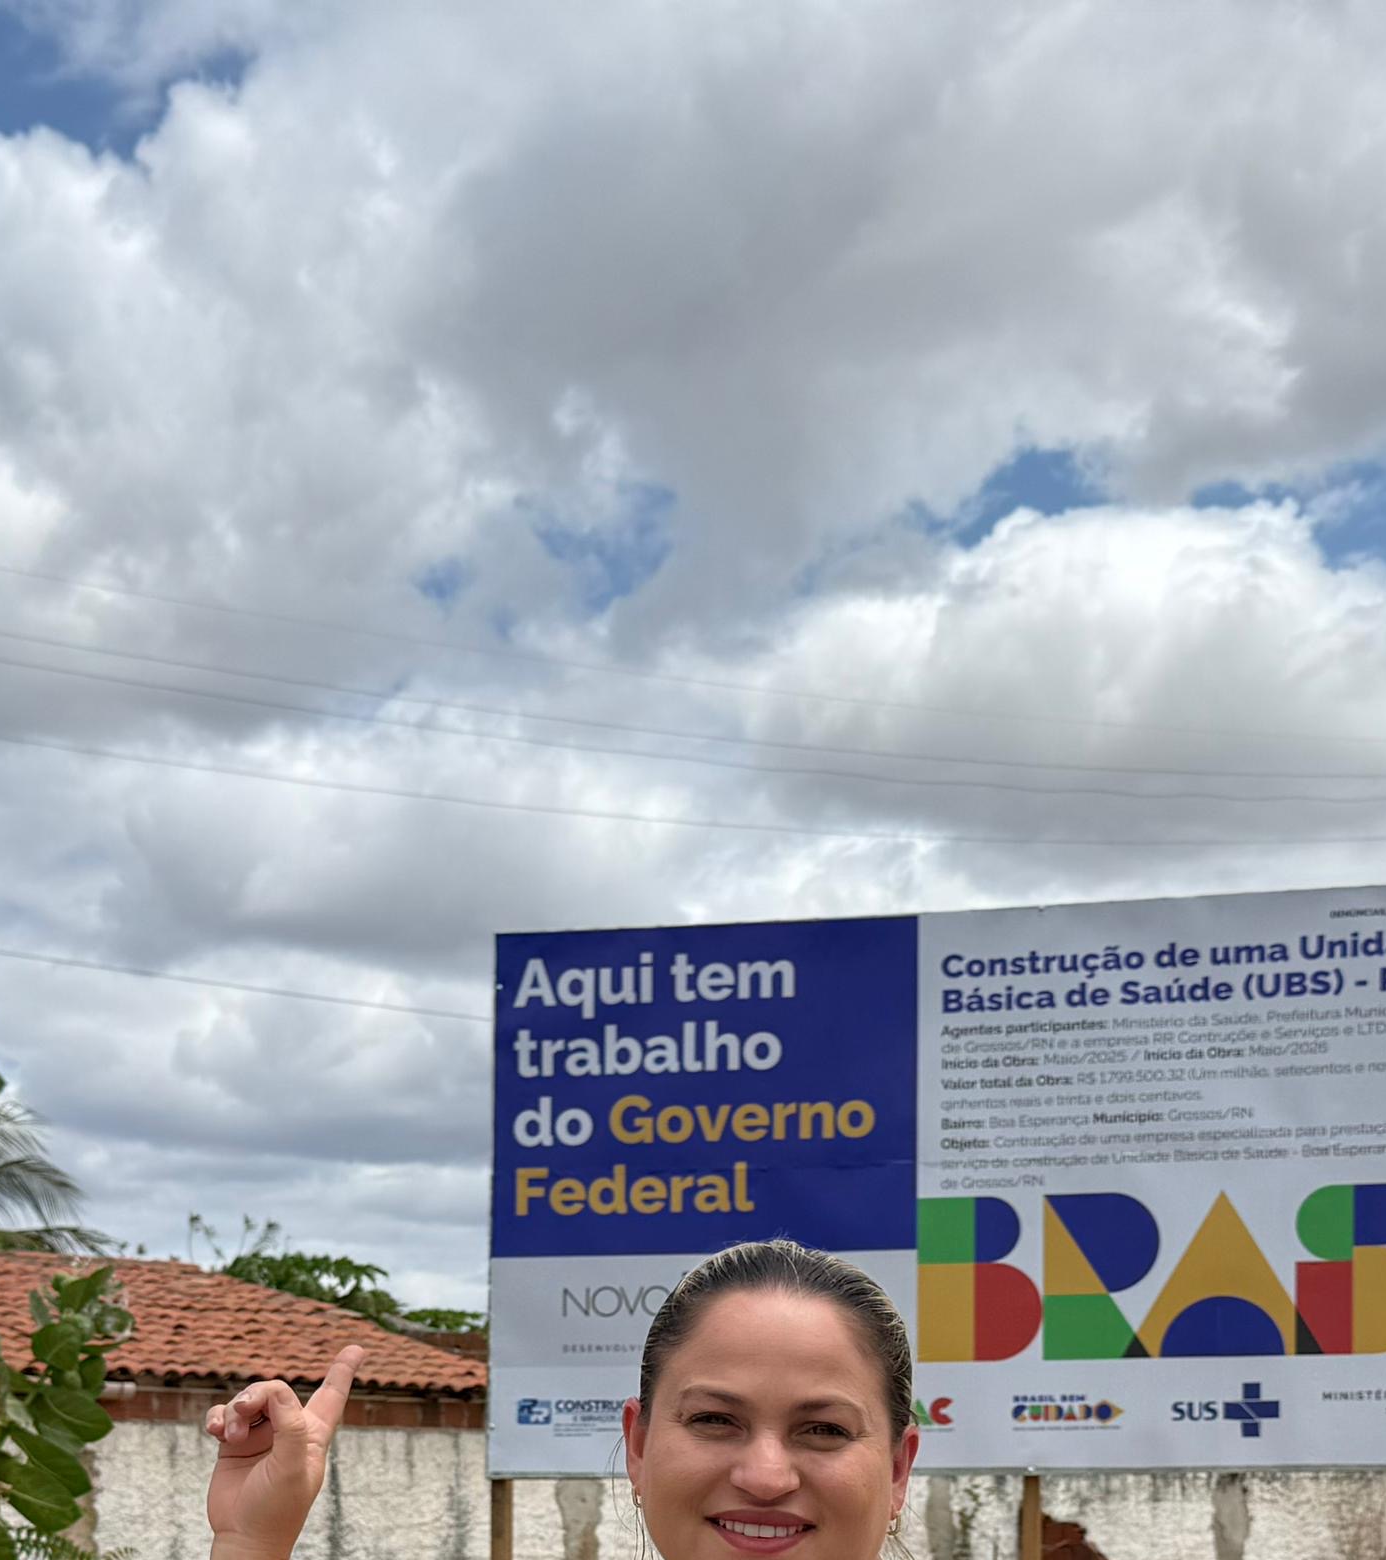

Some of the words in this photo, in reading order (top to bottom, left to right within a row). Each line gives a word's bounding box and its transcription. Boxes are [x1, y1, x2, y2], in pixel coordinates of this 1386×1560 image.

[940, 945, 1145, 979] Construção
[1154, 942, 1201, 968] de
[1210, 943, 1289, 965] uma
[513, 951, 654, 1019] Aqui
[670, 952, 796, 1002] tem
[941, 985, 1056, 1014] Básica
[1064, 982, 1111, 1008] de
[1120, 976, 1234, 1006] Saúde
[1243, 968, 1344, 1001] (UBS)
[940, 1024, 1002, 1039] Agentes
[1005, 1019, 1108, 1036] participantes:
[1113, 1015, 1185, 1029] Ministério
[1188, 1015, 1207, 1027] da
[1266, 1008, 1342, 1023] Prefeitura
[513, 1020, 782, 1078] trabalho
[941, 1043, 960, 1054] de
[963, 1038, 1054, 1053] Grossos/RN
[1057, 1039, 1067, 1049] e
[1070, 1038, 1080, 1049] a
[1083, 1035, 1149, 1048] empresa
[1153, 1032, 1175, 1044] RR
[1260, 1029, 1271, 1039] e
[1274, 1025, 1339, 1039] Serviços
[1343, 1025, 1353, 1036] e
[941, 1057, 978, 1070] Início
[981, 1057, 999, 1068] da
[1002, 1055, 1039, 1068] Obra:
[1043, 1051, 1128, 1065] Maio/2025
[1143, 1050, 1182, 1061] Início
[1185, 1048, 1203, 1060] da
[1206, 1046, 1243, 1059] Obra:
[941, 1078, 977, 1091] Valor
[980, 1077, 1013, 1089] total
[1015, 1075, 1033, 1088] da
[1036, 1074, 1073, 1087] Obra:
[1274, 1063, 1351, 1078] setecentos
[1355, 1063, 1366, 1073] e
[1044, 1096, 1054, 1106] e
[1056, 1095, 1092, 1106] trinta
[1095, 1094, 1104, 1105] e
[1106, 1091, 1136, 1104] dois
[513, 1096, 594, 1147] do
[609, 1094, 876, 1144] Governo
[941, 1117, 986, 1131] Bairro:
[989, 1115, 1016, 1129] Boa
[1018, 1114, 1089, 1129] Esperança
[1092, 1109, 1164, 1126] Município:
[940, 1138, 990, 1152] Objeto:
[993, 1133, 1077, 1149] Contratação
[1078, 1133, 1096, 1145] de
[1100, 1132, 1130, 1144] uma
[1133, 1130, 1195, 1144] empresa
[1197, 1126, 1292, 1142] especializada
[1295, 1125, 1326, 1140] para
[991, 1157, 1009, 1169] de
[1091, 1152, 1108, 1165] de
[1112, 1150, 1171, 1164] Unidade
[1221, 1147, 1239, 1160] de
[515, 1161, 756, 1216] Federal
[940, 1177, 958, 1190] de
[562, 1285, 670, 1318] NOVO
[555, 1398, 625, 1412] CONSTRU
[1011, 1400, 1125, 1424] CUIDADO
[1171, 1401, 1219, 1422] SUS
